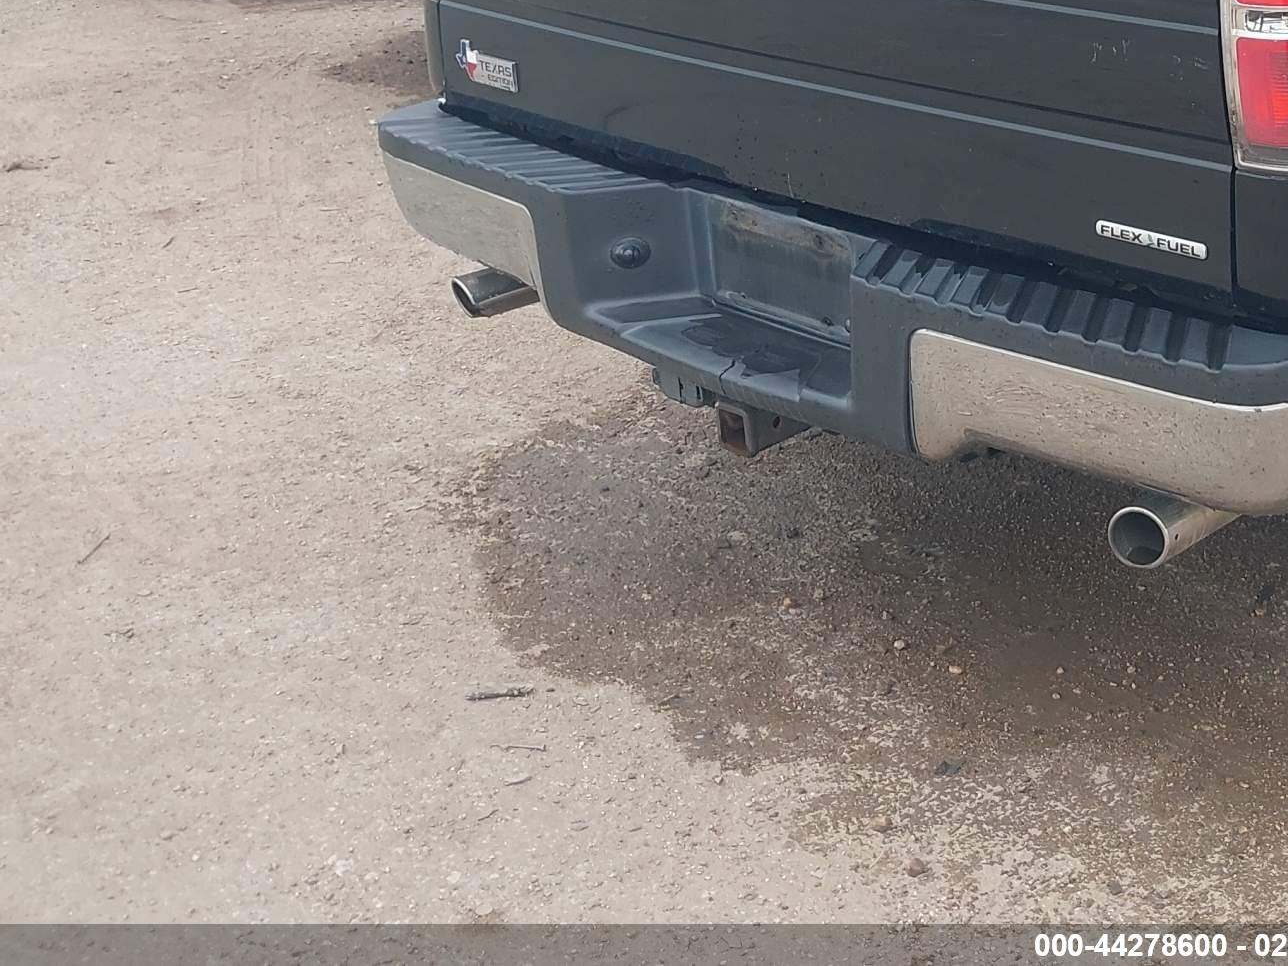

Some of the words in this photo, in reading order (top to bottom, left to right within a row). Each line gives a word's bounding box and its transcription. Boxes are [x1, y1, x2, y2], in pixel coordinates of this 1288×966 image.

[479, 60, 512, 78] TEXAS
[1100, 224, 1143, 244] FLEX
[1156, 237, 1201, 258] FUEL
